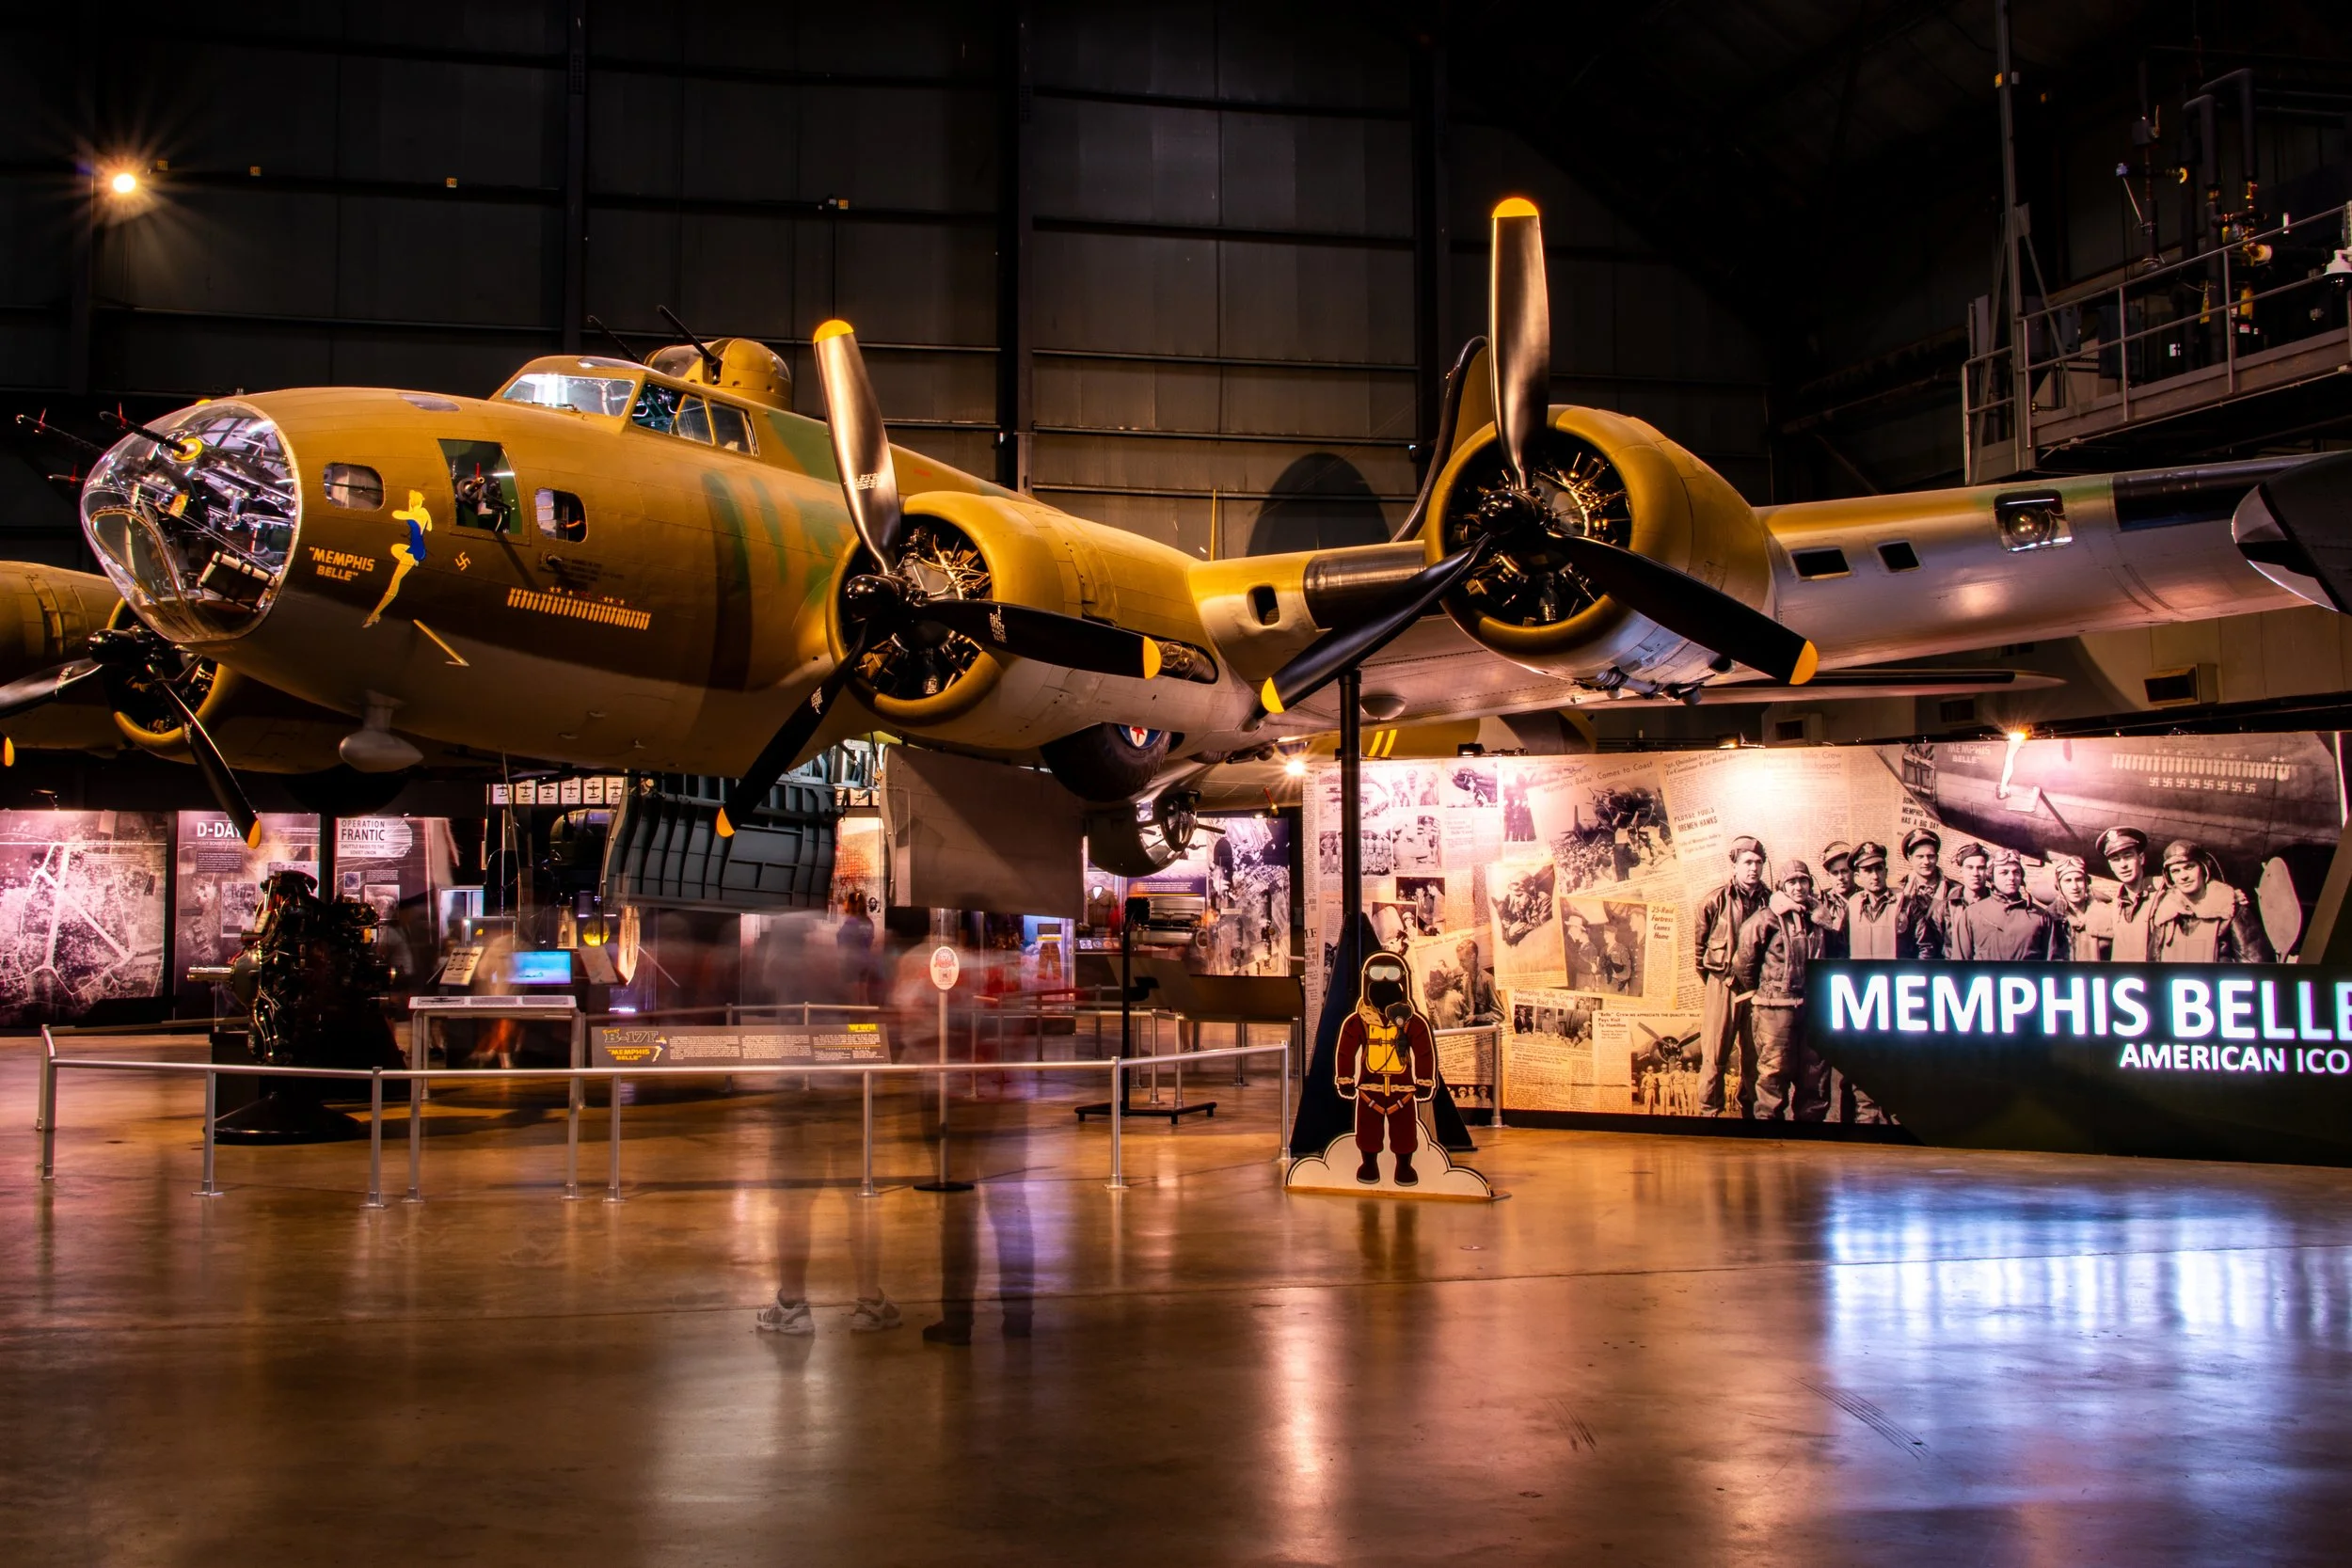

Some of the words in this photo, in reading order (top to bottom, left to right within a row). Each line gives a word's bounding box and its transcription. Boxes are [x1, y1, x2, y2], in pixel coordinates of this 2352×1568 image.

[309, 546, 375, 572] "MEMPHIS
[316, 564, 358, 581] BELLE"
[1597, 770, 1620, 780] Comes
[1632, 760, 1653, 771] Coast
[1902, 796, 1916, 805] BOM
[1902, 806, 1924, 817] MEMPHIS
[1677, 820, 1698, 832] BREMEN
[1699, 816, 1718, 827] HAWKS
[1901, 816, 1911, 825] HAS
[1919, 819, 1928, 828] BIG
[1930, 821, 1940, 831] DAY
[342, 829, 385, 841] FRANTIC
[1514, 995, 1533, 1004] Relates
[1831, 974, 2150, 1037] MEMPHIS
[605, 1031, 659, 1043] B-17F
[2120, 1043, 2284, 1072] AMERICAN
[2296, 1048, 2351, 1074] ICO
